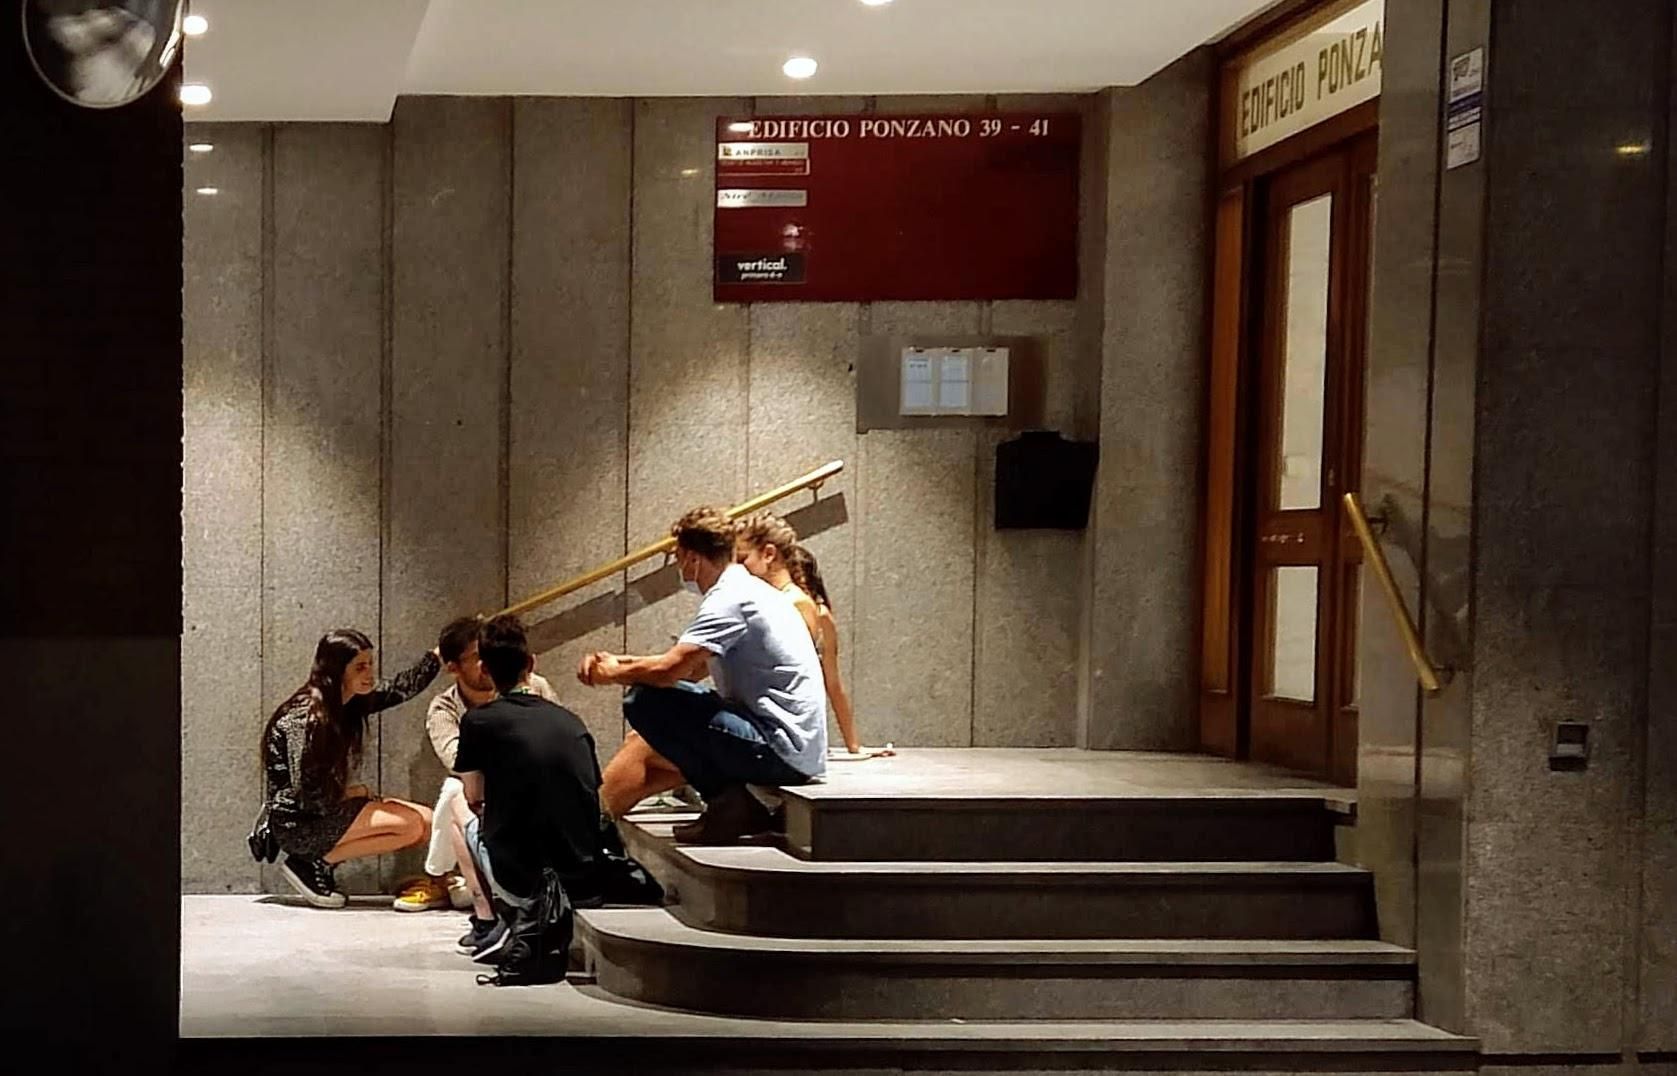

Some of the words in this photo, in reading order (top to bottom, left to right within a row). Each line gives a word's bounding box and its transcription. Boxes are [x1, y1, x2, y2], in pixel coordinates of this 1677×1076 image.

[1241, 61, 1305, 138] EDIFICIO
[749, 119, 850, 138] EDIFICIO
[859, 119, 970, 138] PONZANO
[979, 119, 1002, 137] 39
[1028, 119, 1049, 136] 41
[736, 257, 788, 271] vertical.
